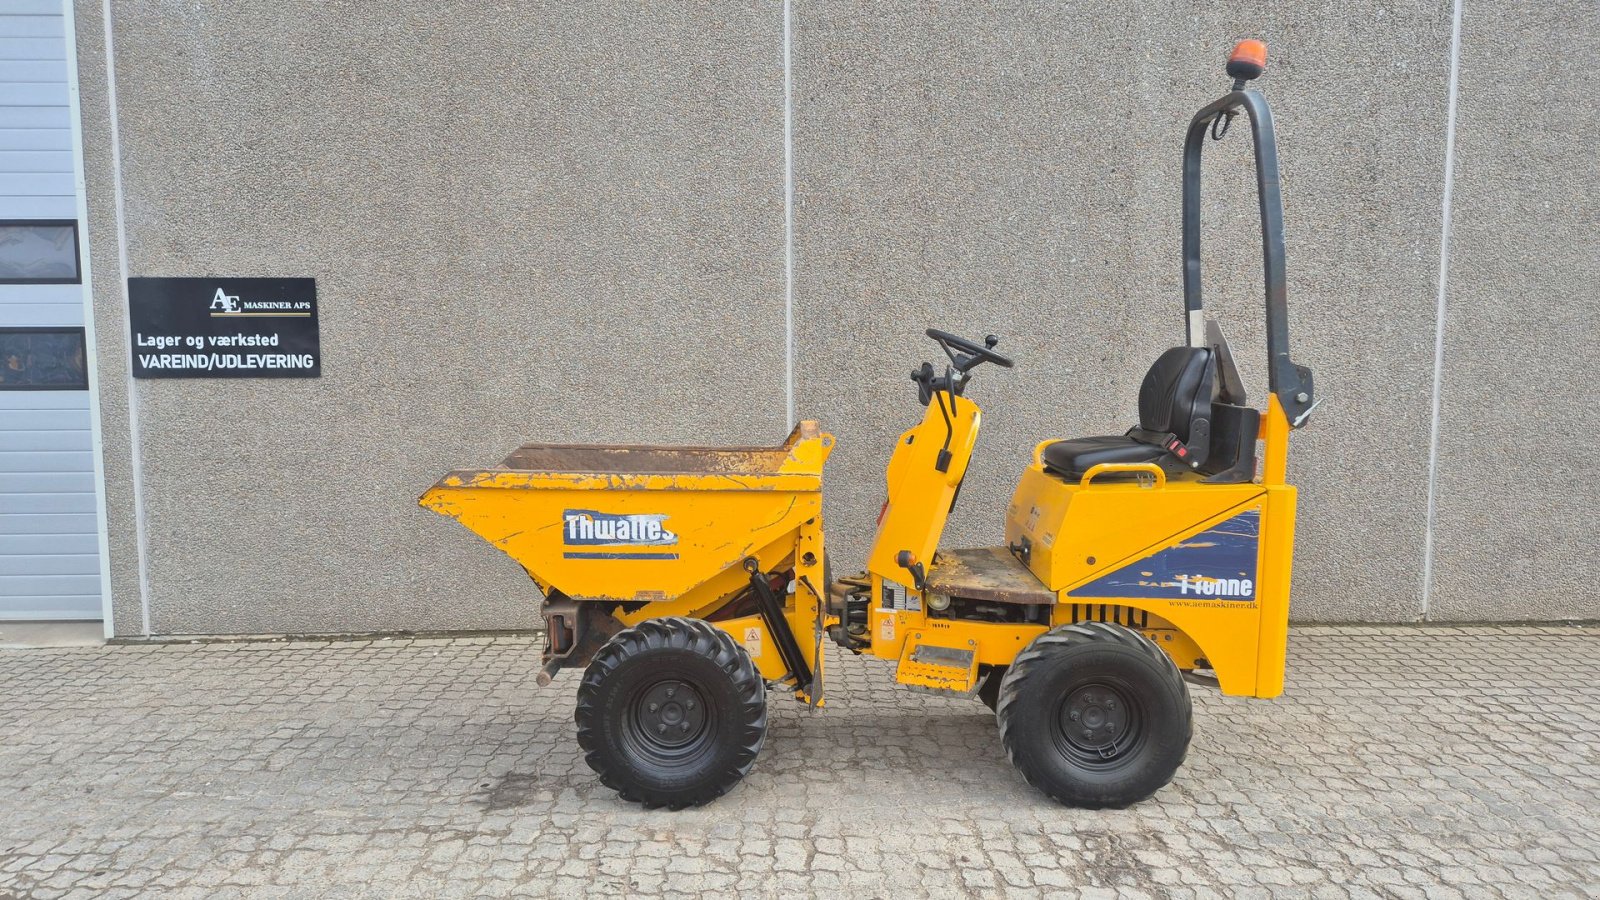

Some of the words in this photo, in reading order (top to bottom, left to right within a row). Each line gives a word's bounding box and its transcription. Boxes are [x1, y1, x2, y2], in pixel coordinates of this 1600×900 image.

[209, 287, 241, 313] AE
[137, 333, 181, 349] Lager
[186, 338, 205, 349] og
[208, 333, 279, 346] værksted
[139, 353, 314, 370] VAREIND/UDLEVERING
[1168, 600, 1258, 609] www.aemaskiner.dk
